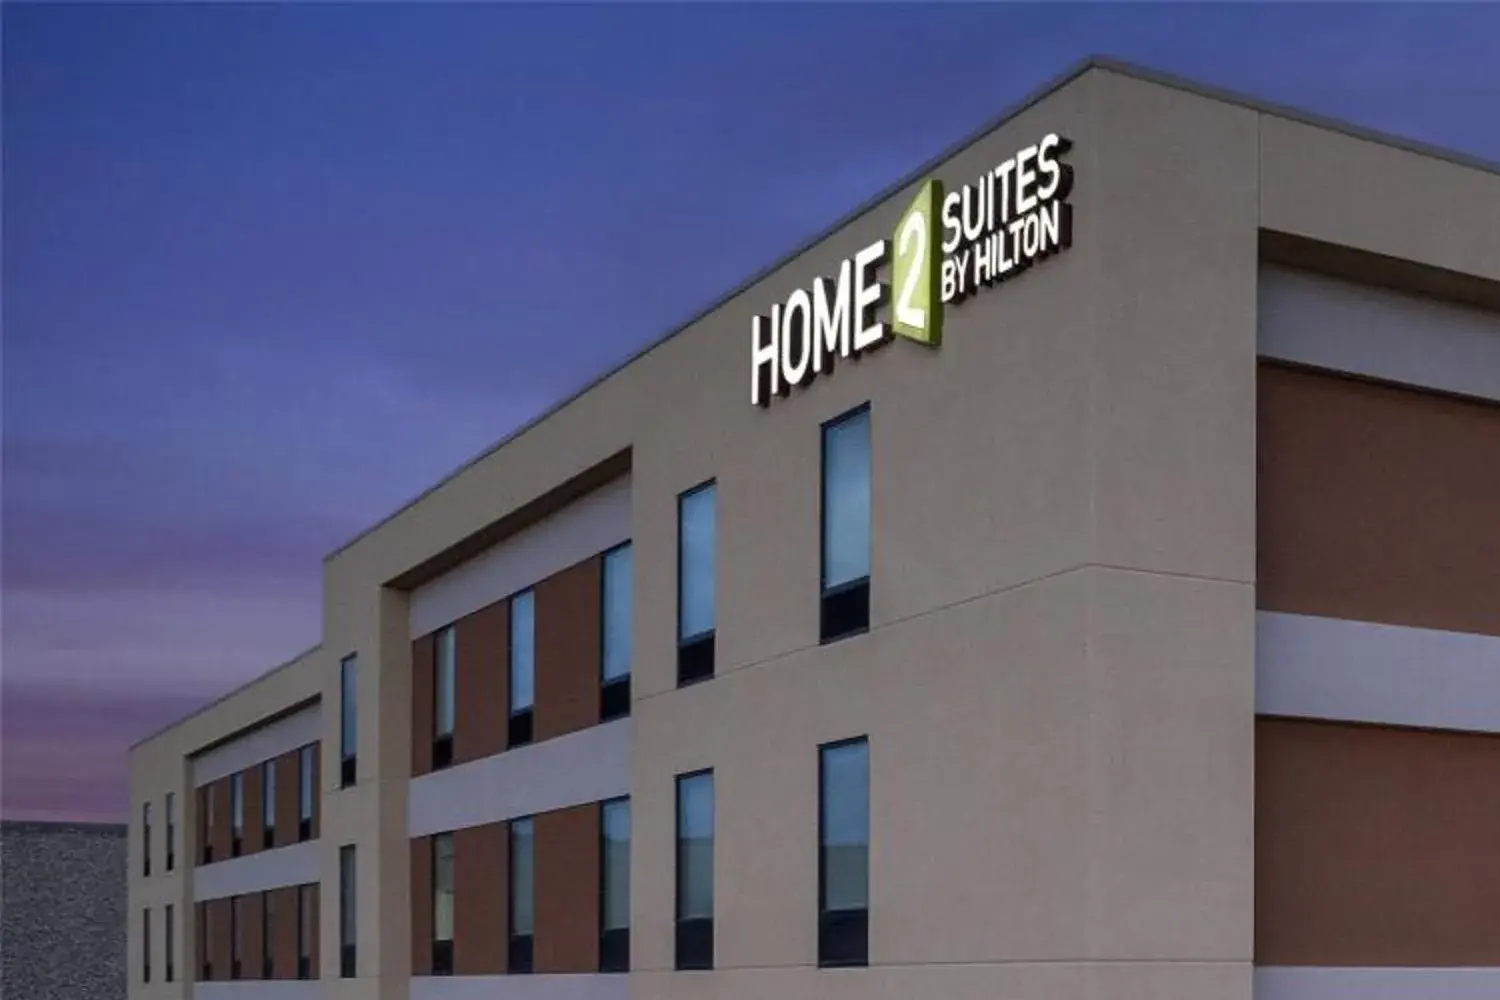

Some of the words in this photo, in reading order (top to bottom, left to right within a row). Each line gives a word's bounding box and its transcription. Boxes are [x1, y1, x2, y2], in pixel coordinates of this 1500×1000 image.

[941, 133, 1060, 253] SUITES
[941, 250, 969, 302] BY
[975, 200, 1059, 285] HILTON
[752, 240, 884, 404] HOME
[896, 211, 926, 328] 2
